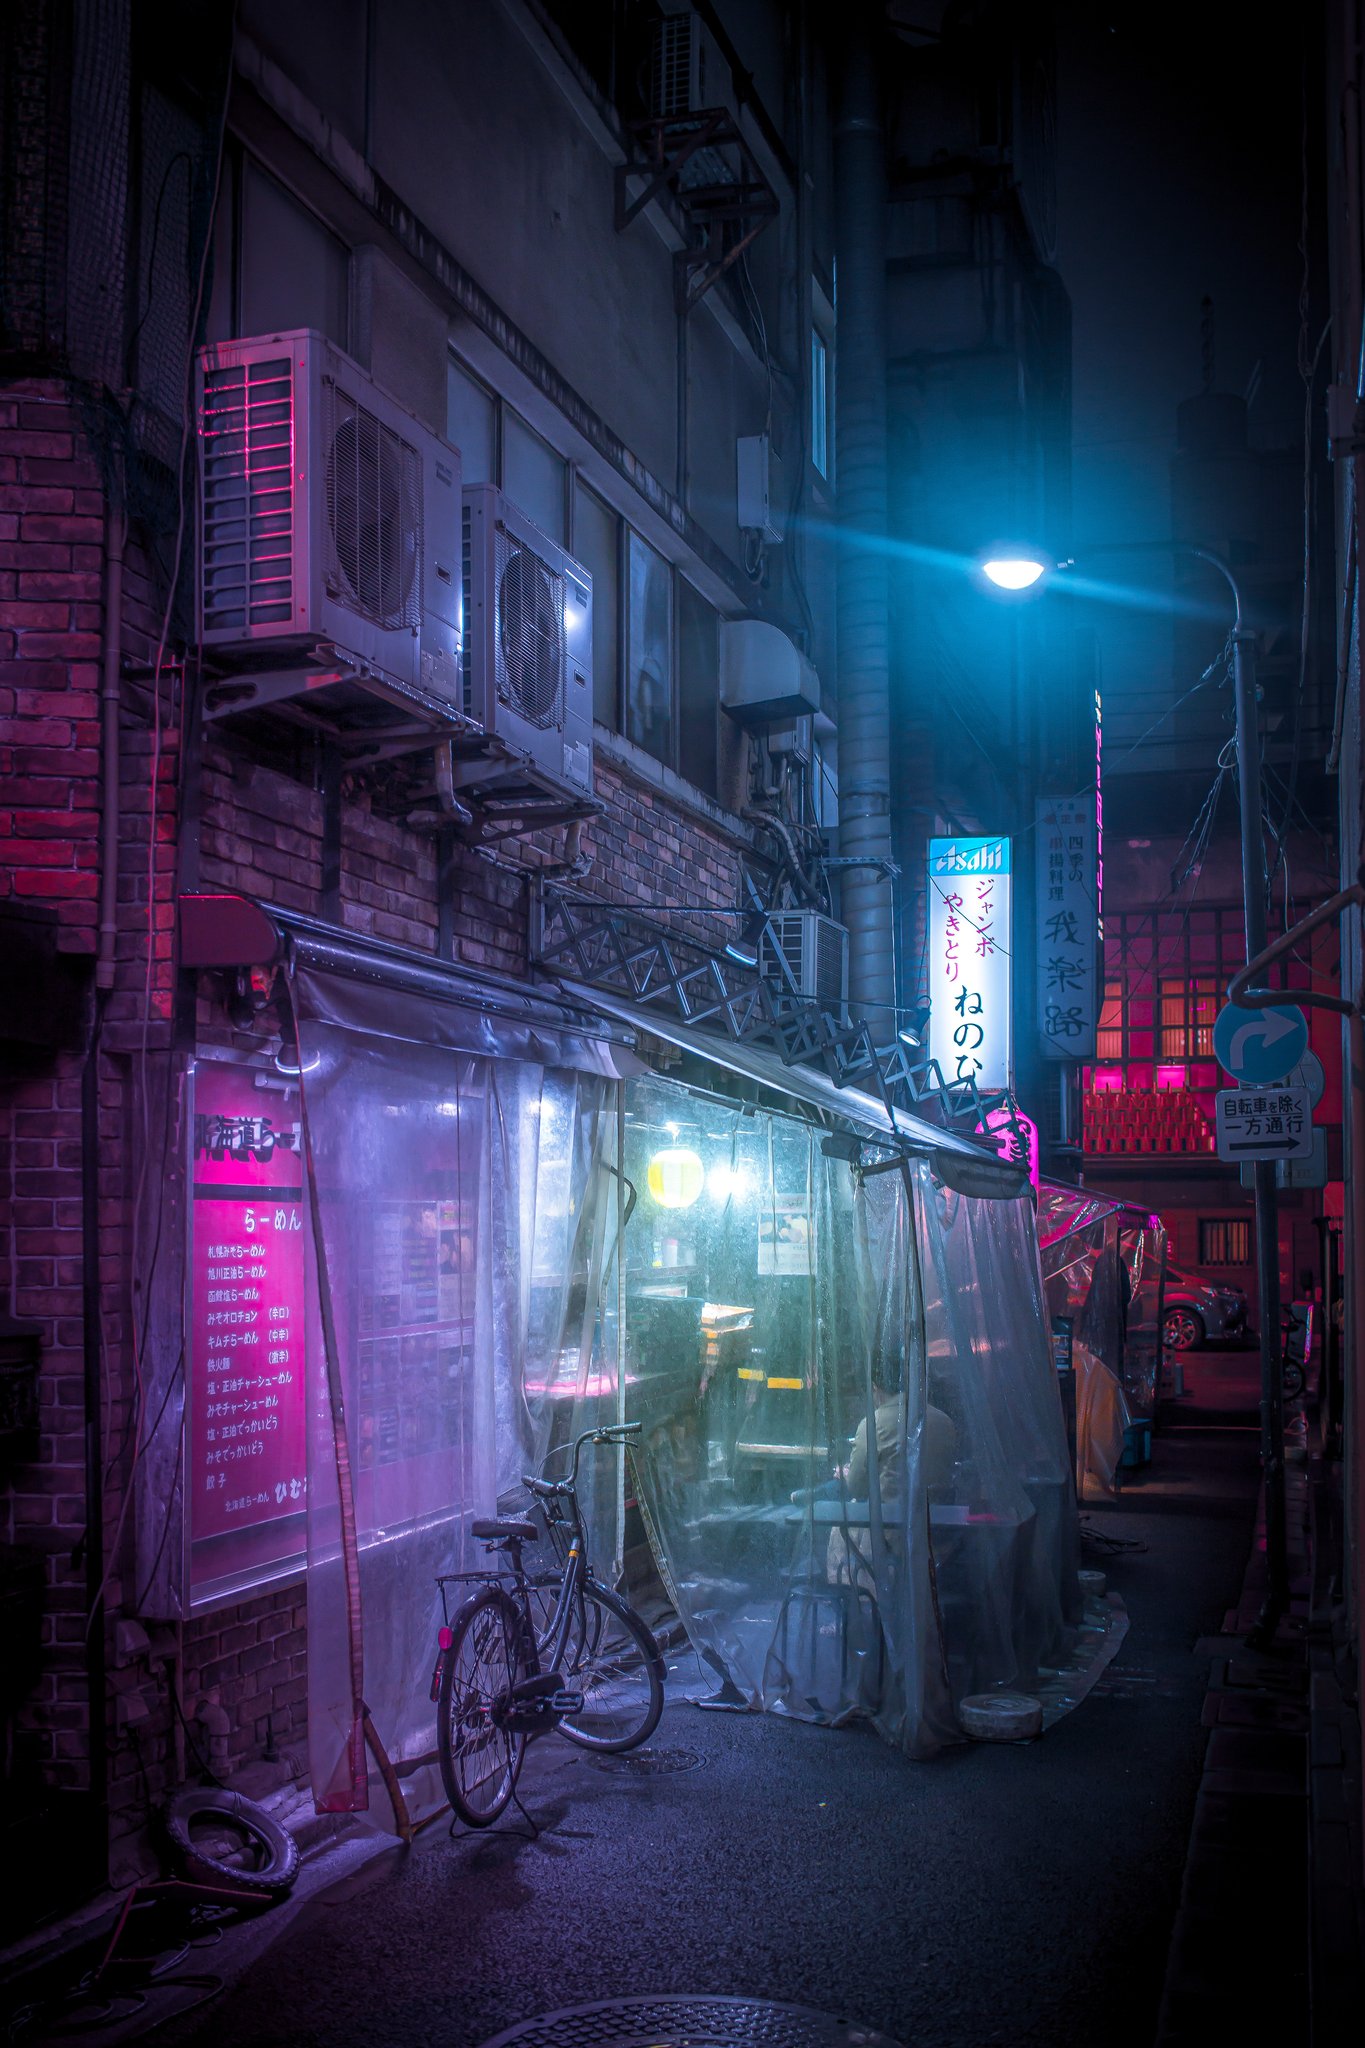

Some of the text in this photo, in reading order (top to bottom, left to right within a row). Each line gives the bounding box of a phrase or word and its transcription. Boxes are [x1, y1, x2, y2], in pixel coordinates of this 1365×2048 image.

[935, 842, 1002, 872] Asahi
[1068, 836, 1084, 882] 四季の
[975, 878, 995, 957] ジャンボ
[943, 892, 963, 982] やきとり
[953, 985, 984, 1081] ねのひ
[1224, 1095, 1303, 1116] 自転車を除く
[1225, 1116, 1304, 1136] 一方通行
[245, 1208, 302, 1233] らーめん
[207, 1245, 266, 1258] 札幌みそらーめん
[207, 1265, 267, 1280] 旭川正油らーめん
[207, 1288, 259, 1303] 函館塩らーめん
[207, 1306, 290, 1326] みそオロチョン (辛口)
[207, 1328, 289, 1349] キムチらーめん (中辛)
[206, 1394, 279, 1418] みそチャーシューめん
[206, 1440, 264, 1465] みそでっかいどう
[225, 1491, 270, 1512] 北海道らーめん
